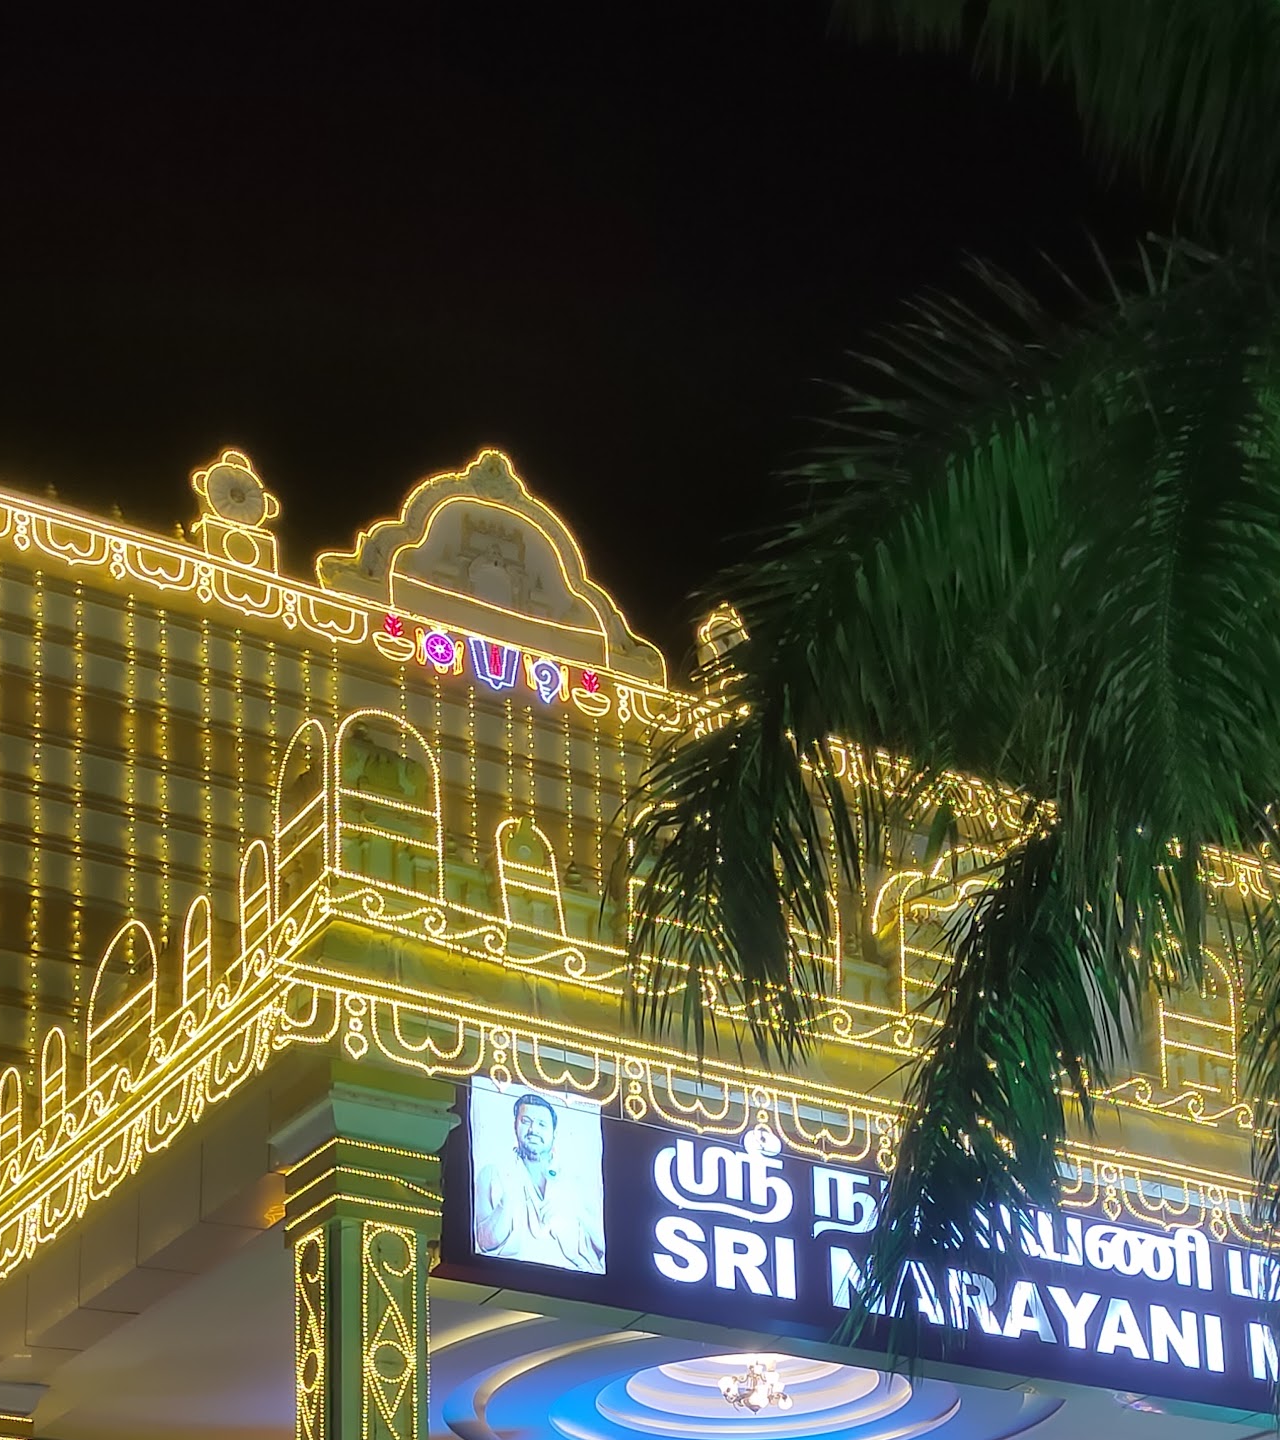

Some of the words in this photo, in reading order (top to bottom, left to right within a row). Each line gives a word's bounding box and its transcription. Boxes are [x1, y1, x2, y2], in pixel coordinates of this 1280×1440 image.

[652, 1215, 798, 1301] SRI
[829, 1245, 1226, 1373] NARAYANI
[811, 1165, 1214, 1291] நயணி
